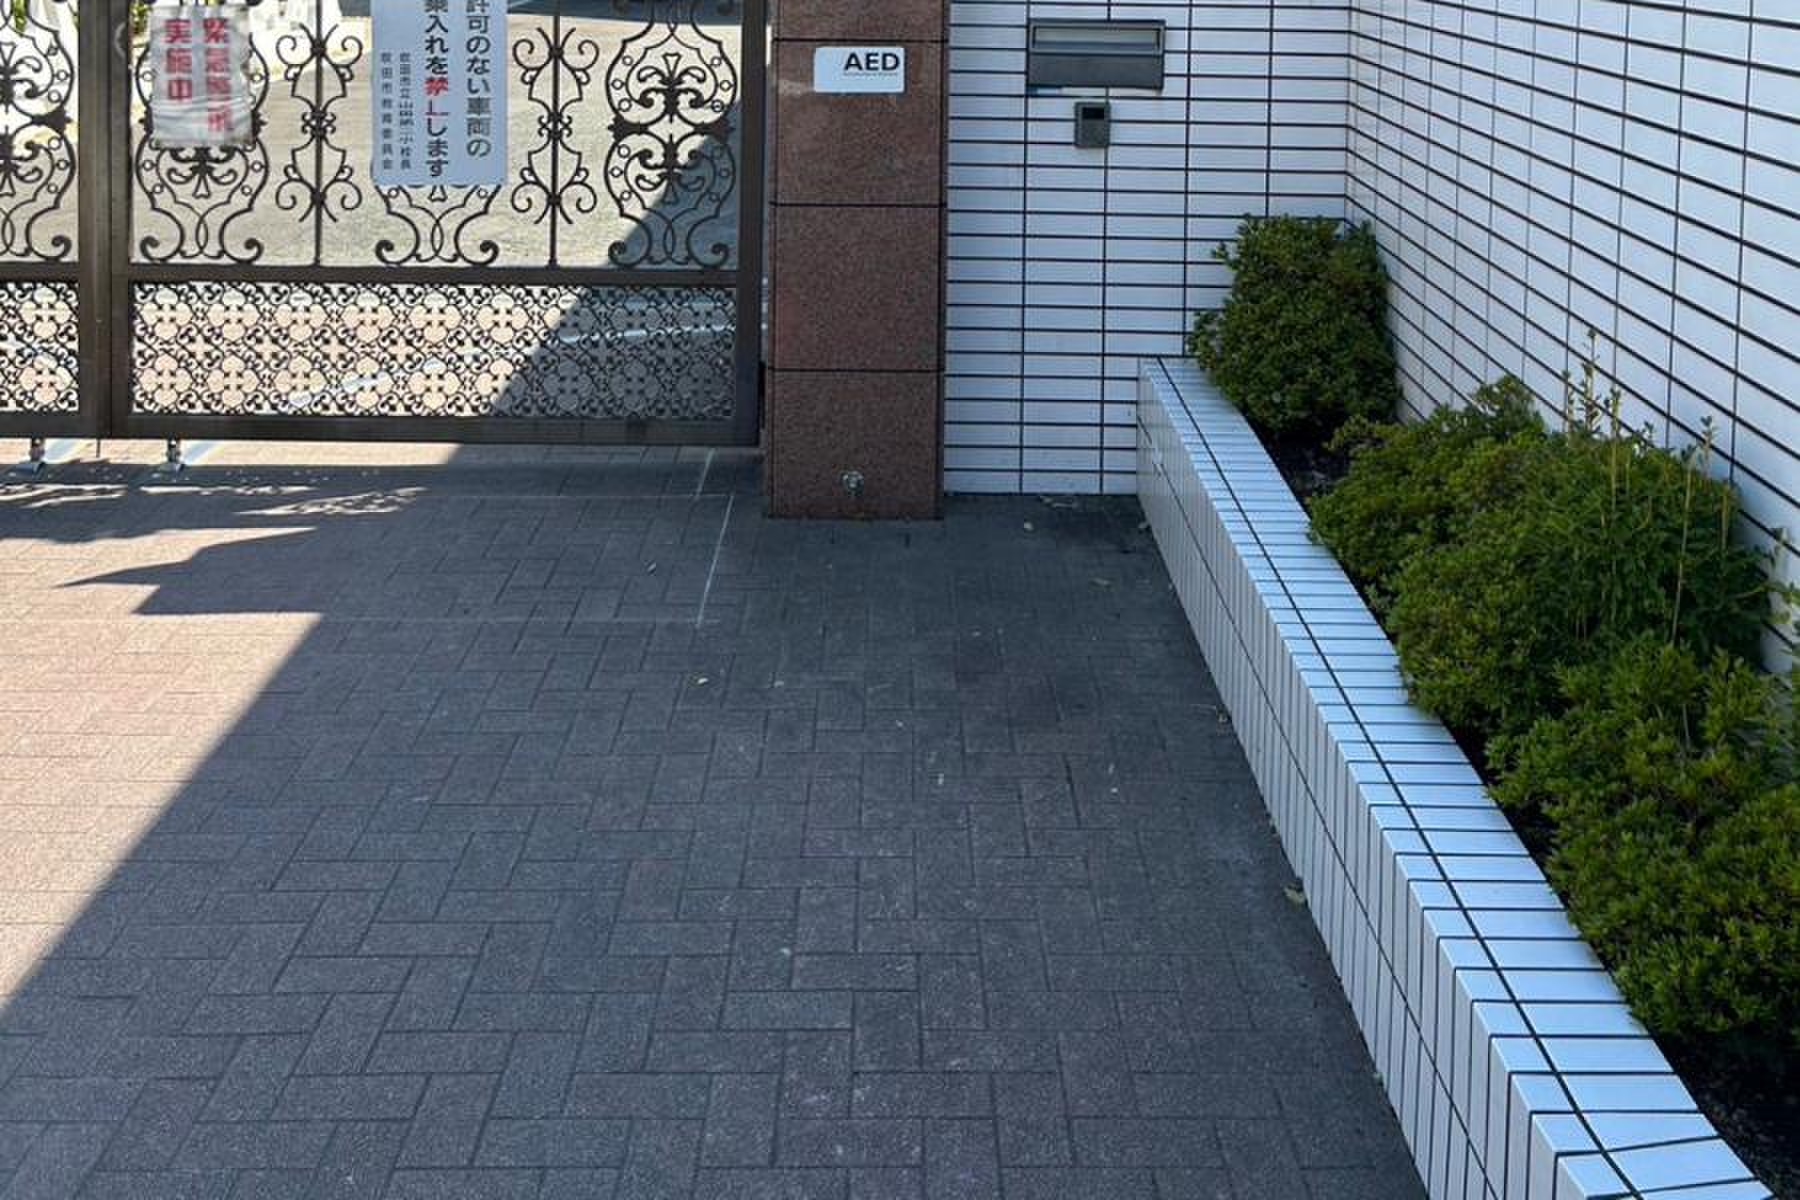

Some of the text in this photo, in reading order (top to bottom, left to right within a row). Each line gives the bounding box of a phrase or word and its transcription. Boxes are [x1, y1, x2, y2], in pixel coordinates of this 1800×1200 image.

[164, 18, 193, 102] 実施中
[844, 52, 900, 71] AED
